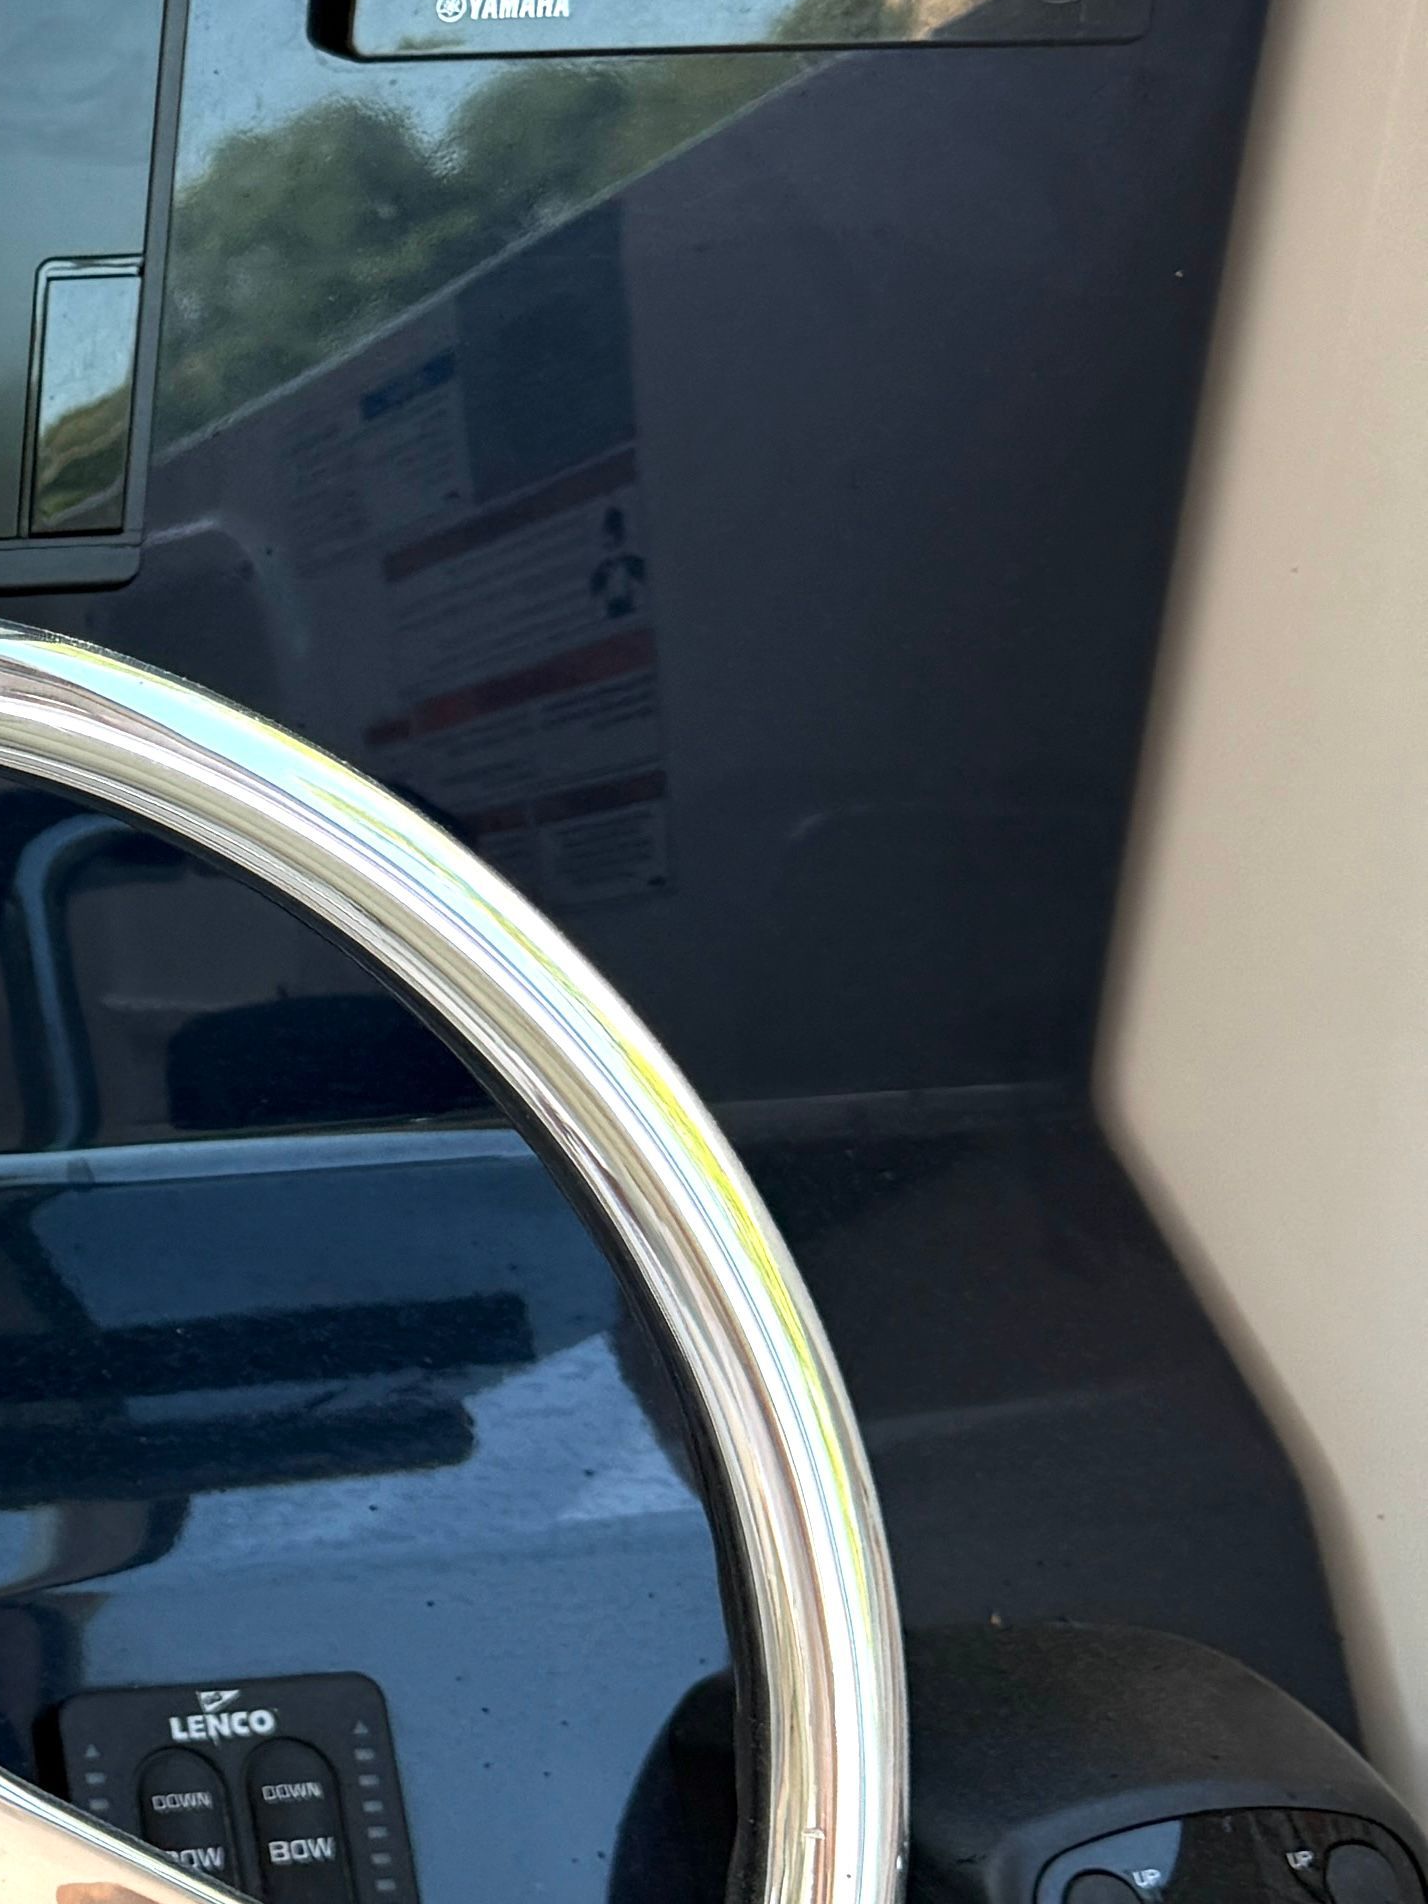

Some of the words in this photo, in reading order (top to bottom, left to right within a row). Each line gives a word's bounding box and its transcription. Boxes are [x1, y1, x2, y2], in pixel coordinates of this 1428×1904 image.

[168, 1708, 278, 1744] LENCO
[151, 1791, 214, 1812] DOWN
[261, 1781, 324, 1802] DOWN
[267, 1836, 336, 1866] BOW
[1285, 1850, 1314, 1871] UP
[1132, 1867, 1162, 1889] UP
